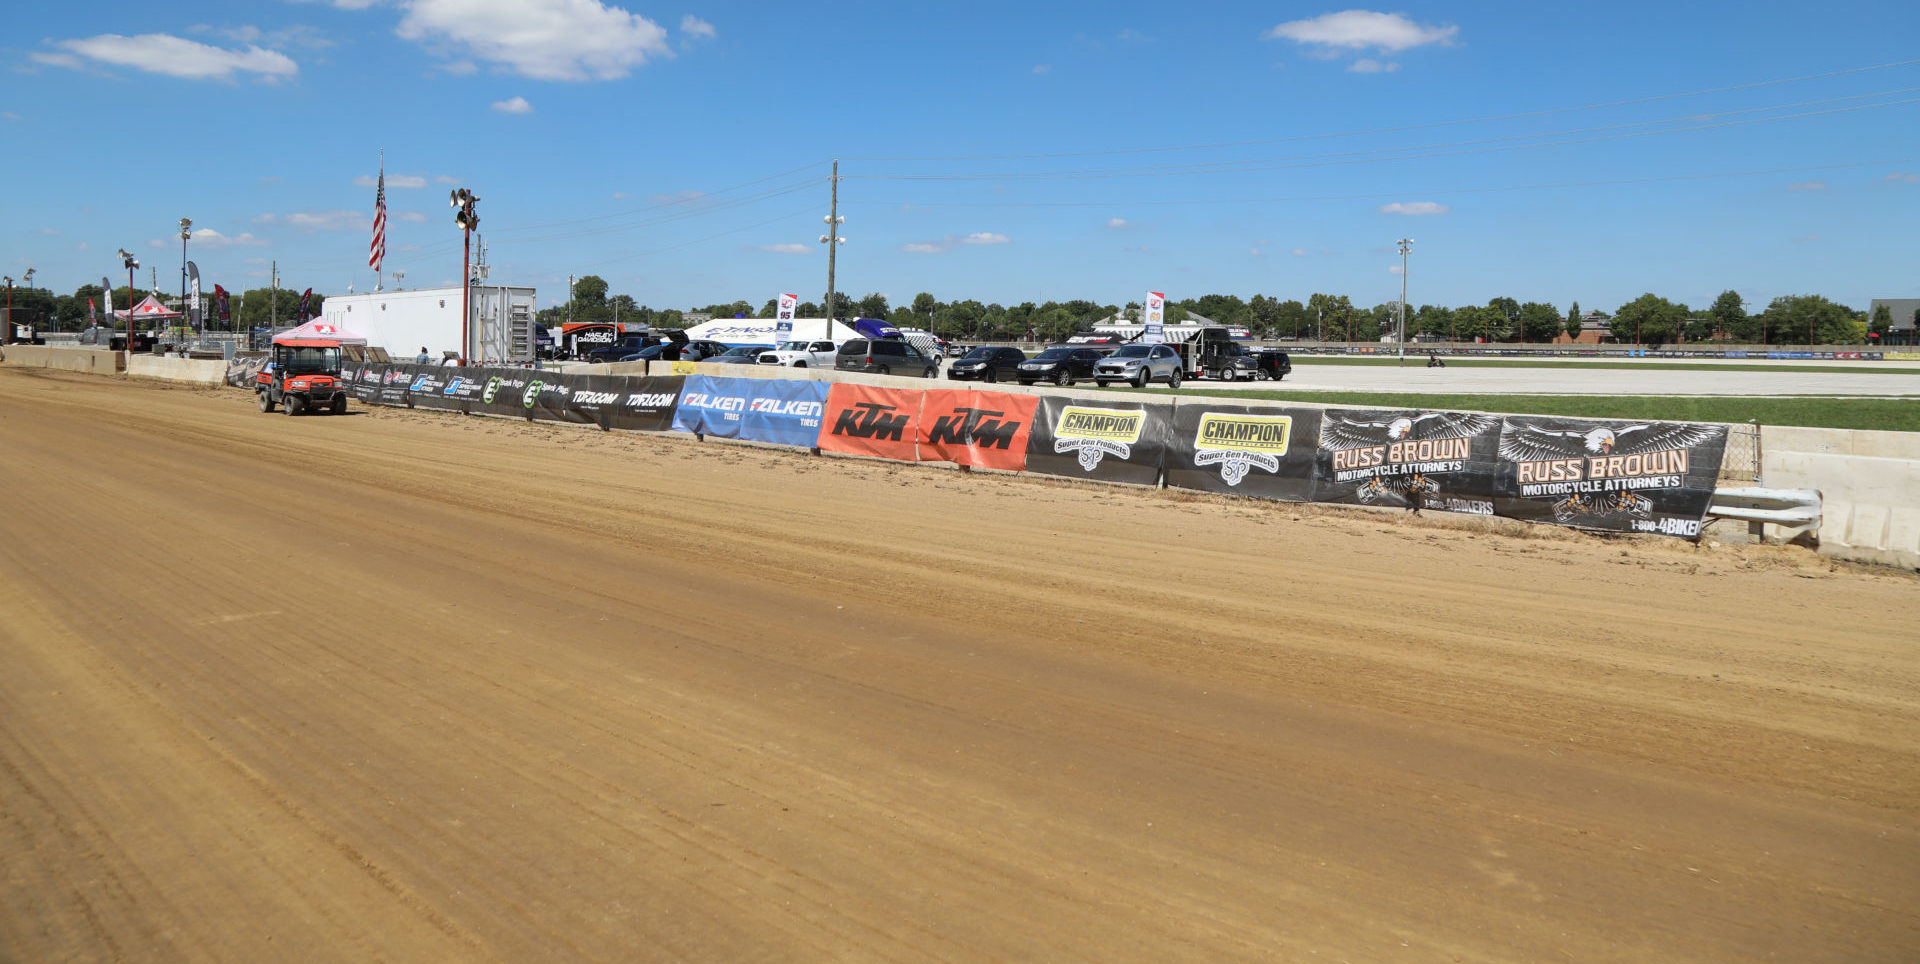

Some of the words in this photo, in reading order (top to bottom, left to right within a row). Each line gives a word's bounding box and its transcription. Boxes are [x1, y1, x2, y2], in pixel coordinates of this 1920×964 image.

[780, 311, 791, 320] 95
[683, 393, 745, 411] FALKEN
[749, 397, 823, 416] FALKEN
[724, 412, 740, 421] TIRES
[800, 418, 819, 427] TIRES
[832, 402, 910, 441] KTM
[1064, 414, 1138, 432] CHAMPION
[929, 407, 1021, 450] KTM
[1204, 421, 1284, 442] CHAMPION
[1057, 440, 1079, 449] Super
[1081, 438, 1096, 446] Gen
[1096, 440, 1127, 456] Products
[1334, 446, 1386, 470] RUSS
[1389, 437, 1470, 463] BROWN
[1198, 451, 1225, 462] Super
[1225, 450, 1241, 458] Gen
[1242, 451, 1275, 469] Products
[1518, 458, 1583, 483] RUSS
[1590, 449, 1688, 478] BROWN
[1336, 464, 1399, 482] MOTORCYCLE
[1400, 460, 1462, 474] ATTORNEYS
[1522, 481, 1602, 496] MOTORCYCLE
[1604, 475, 1680, 491] ATTORNEYS
[1631, 517, 1700, 536] 1-800-4BIKE
